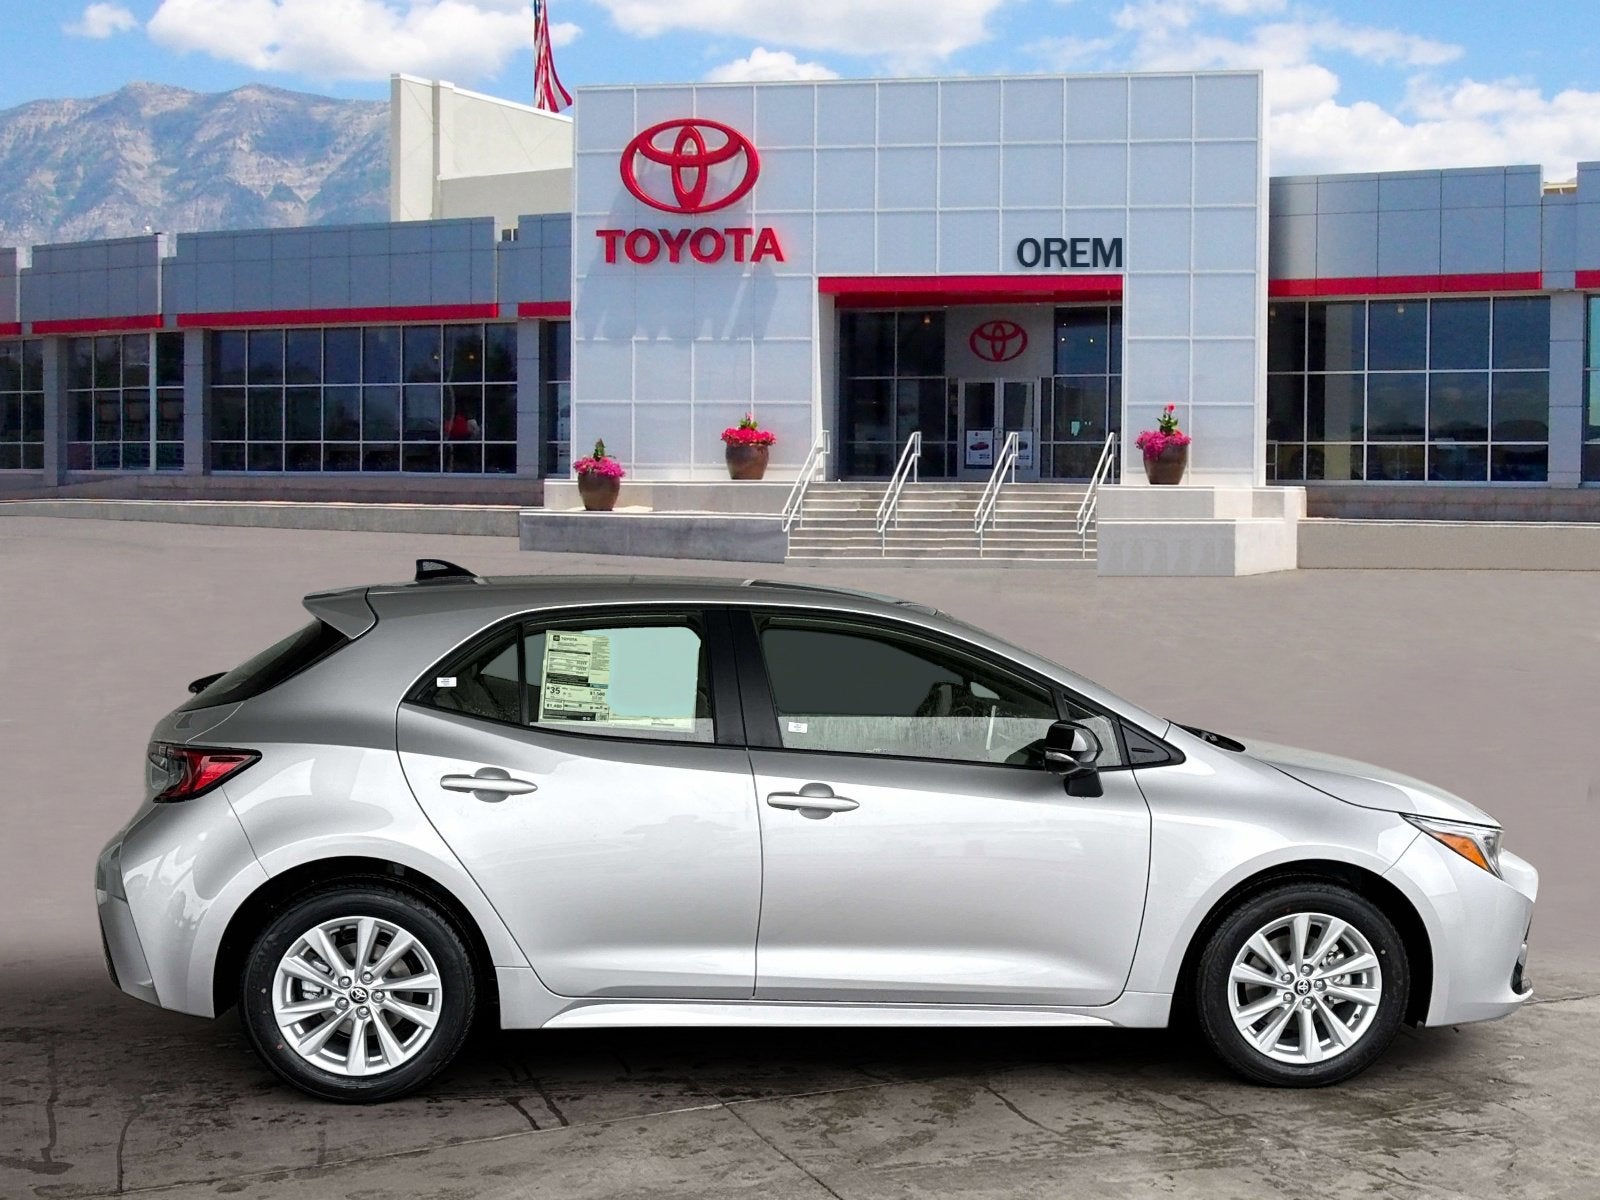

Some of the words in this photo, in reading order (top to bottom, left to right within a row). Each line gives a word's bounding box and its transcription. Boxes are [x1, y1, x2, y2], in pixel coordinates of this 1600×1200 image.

[596, 227, 784, 264] TOYOTA
[1017, 238, 1123, 267] OREM
[549, 686, 561, 695] 35
